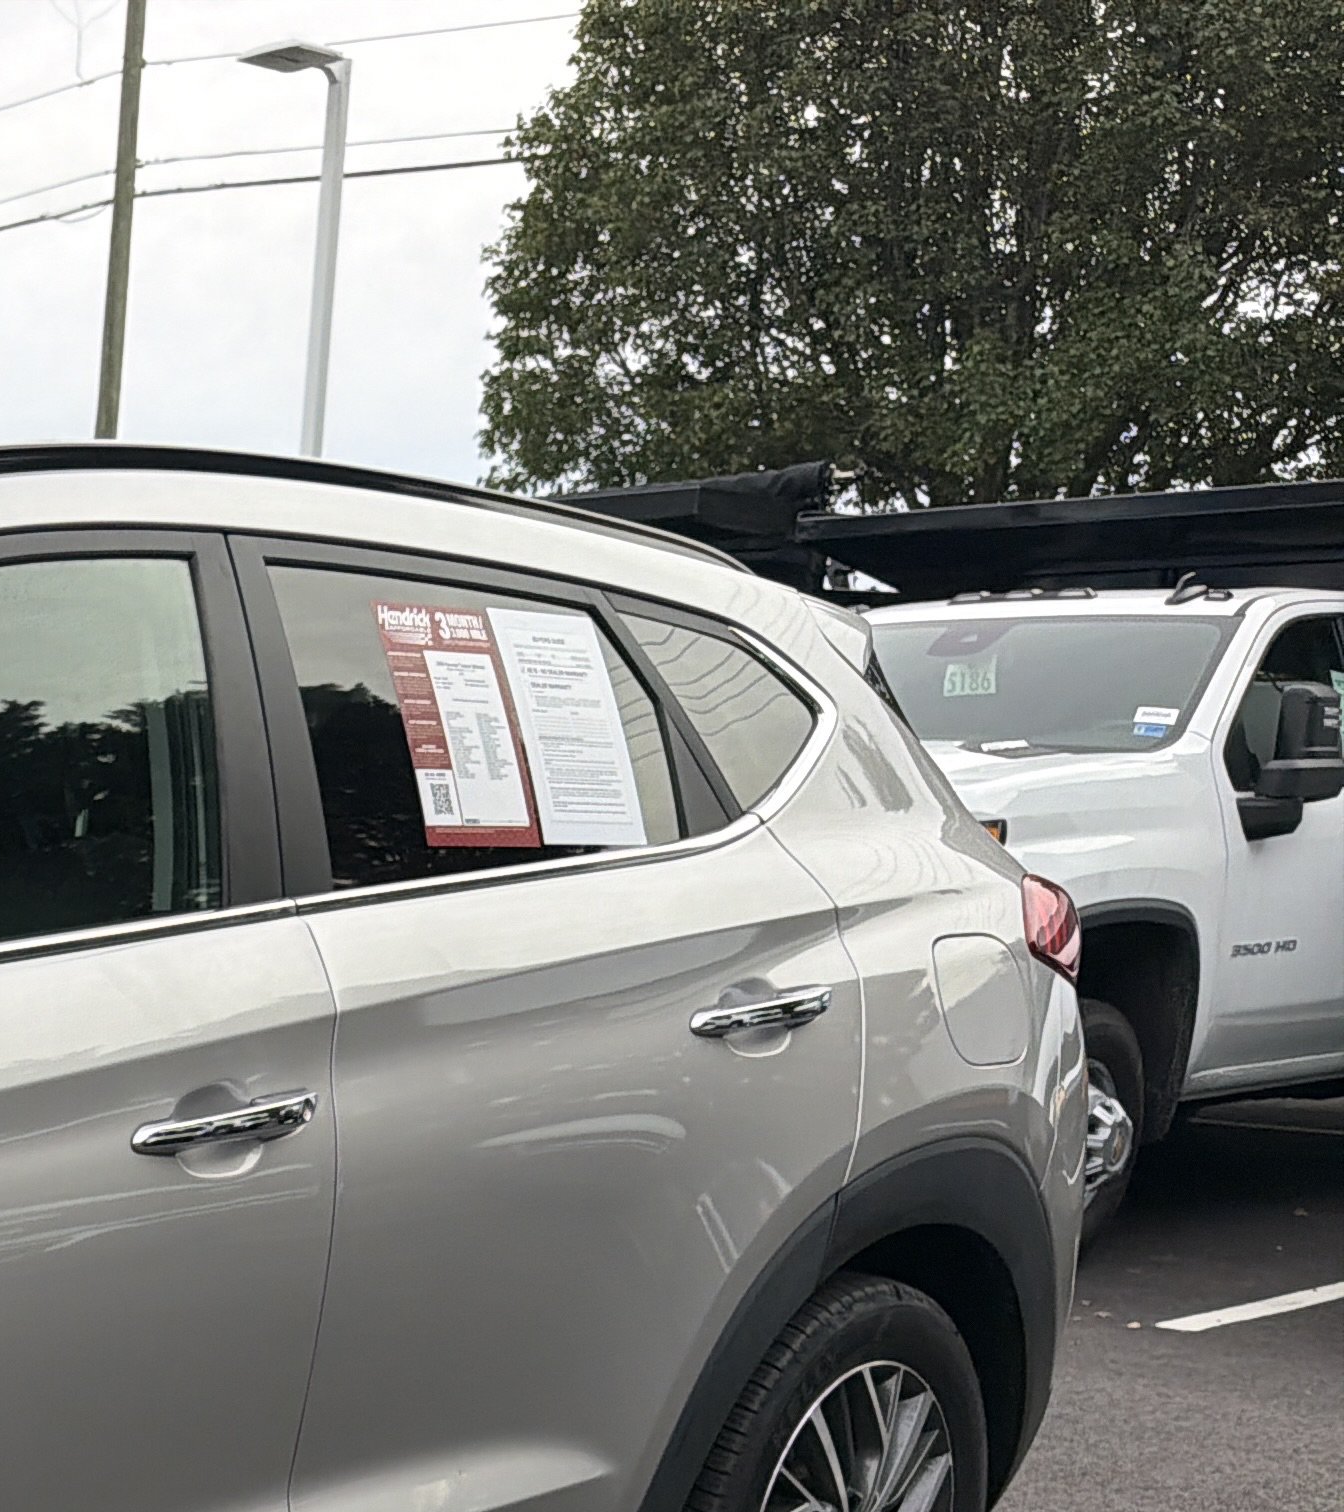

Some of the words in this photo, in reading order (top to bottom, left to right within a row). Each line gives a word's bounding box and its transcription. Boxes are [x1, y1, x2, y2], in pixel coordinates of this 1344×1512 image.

[377, 605, 432, 630] Hendrick
[435, 612, 451, 639] 3
[946, 672, 992, 693] 5186
[1231, 942, 1273, 958] 3500
[1274, 939, 1298, 954] HD
